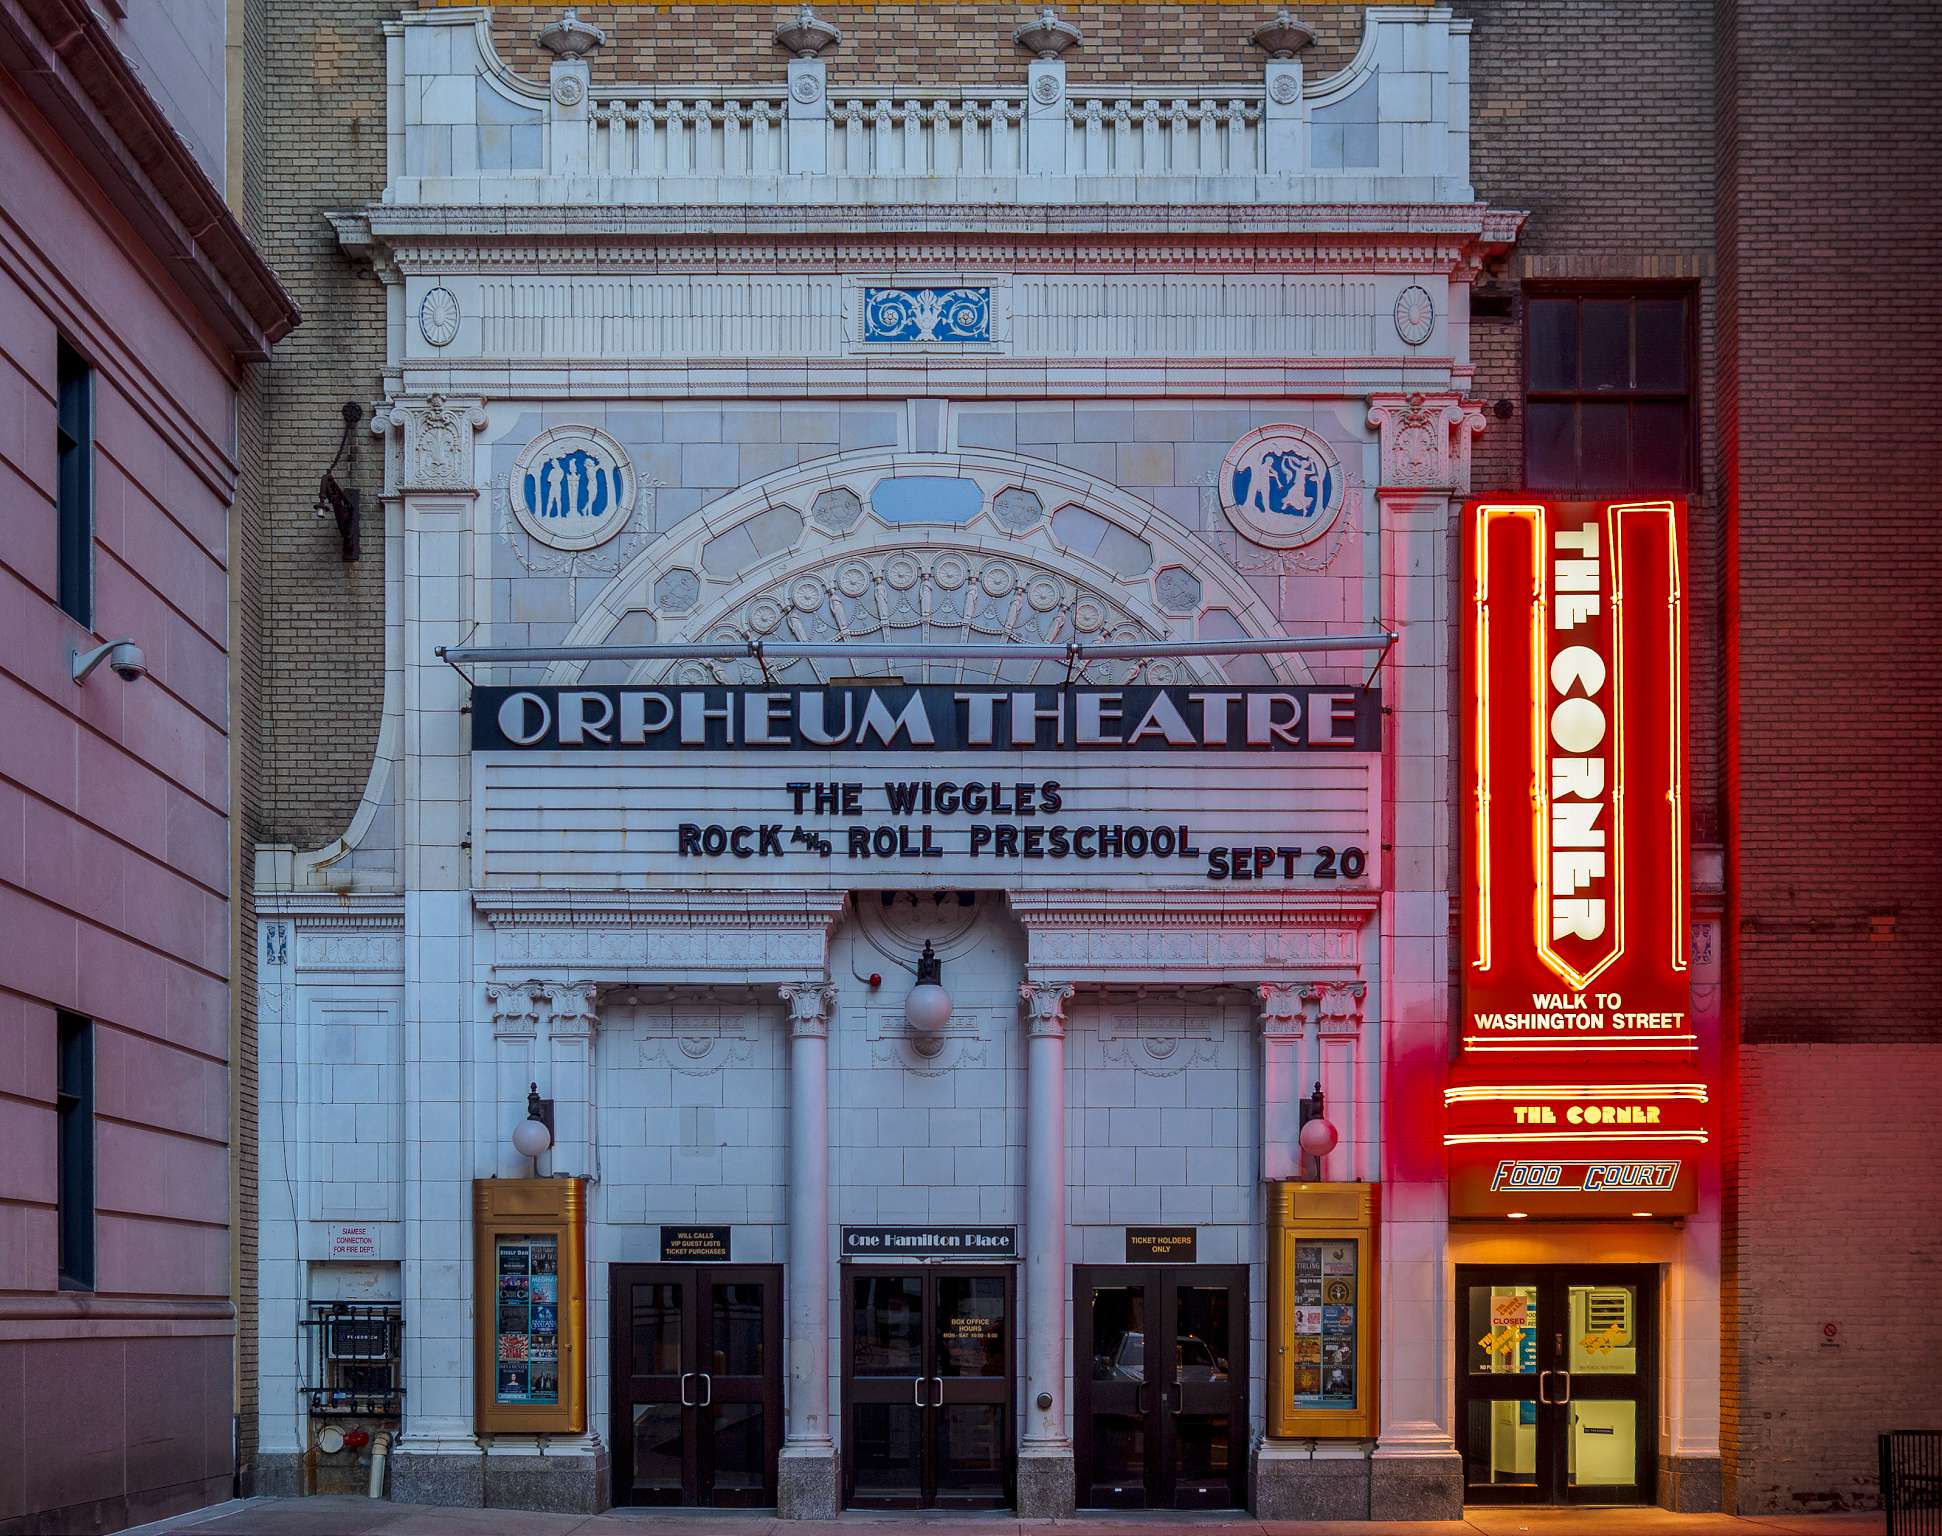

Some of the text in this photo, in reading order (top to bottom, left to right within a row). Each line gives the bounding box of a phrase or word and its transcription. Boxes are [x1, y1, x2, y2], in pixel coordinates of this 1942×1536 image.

[498, 688, 1355, 747] ORPHEUM THEATRE
[1550, 522, 1606, 941] THE CORNER
[786, 780, 1063, 816] THE WIGGLES
[678, 823, 1199, 858] ROCK AND ROLL PRESCHOOL
[1207, 846, 1366, 880] SEPT 20
[1532, 993, 1622, 1009] WALK TO
[1474, 1013, 1684, 1030] WASHINGTON STREET
[1513, 1106, 1660, 1124] THE CORNER
[1490, 1160, 1677, 1191] FOOD COURT
[848, 1233, 1009, 1247] One Hamilton Place
[1131, 1236, 1192, 1244] TICKET HOLDERS
[1151, 1245, 1171, 1253] ONLY
